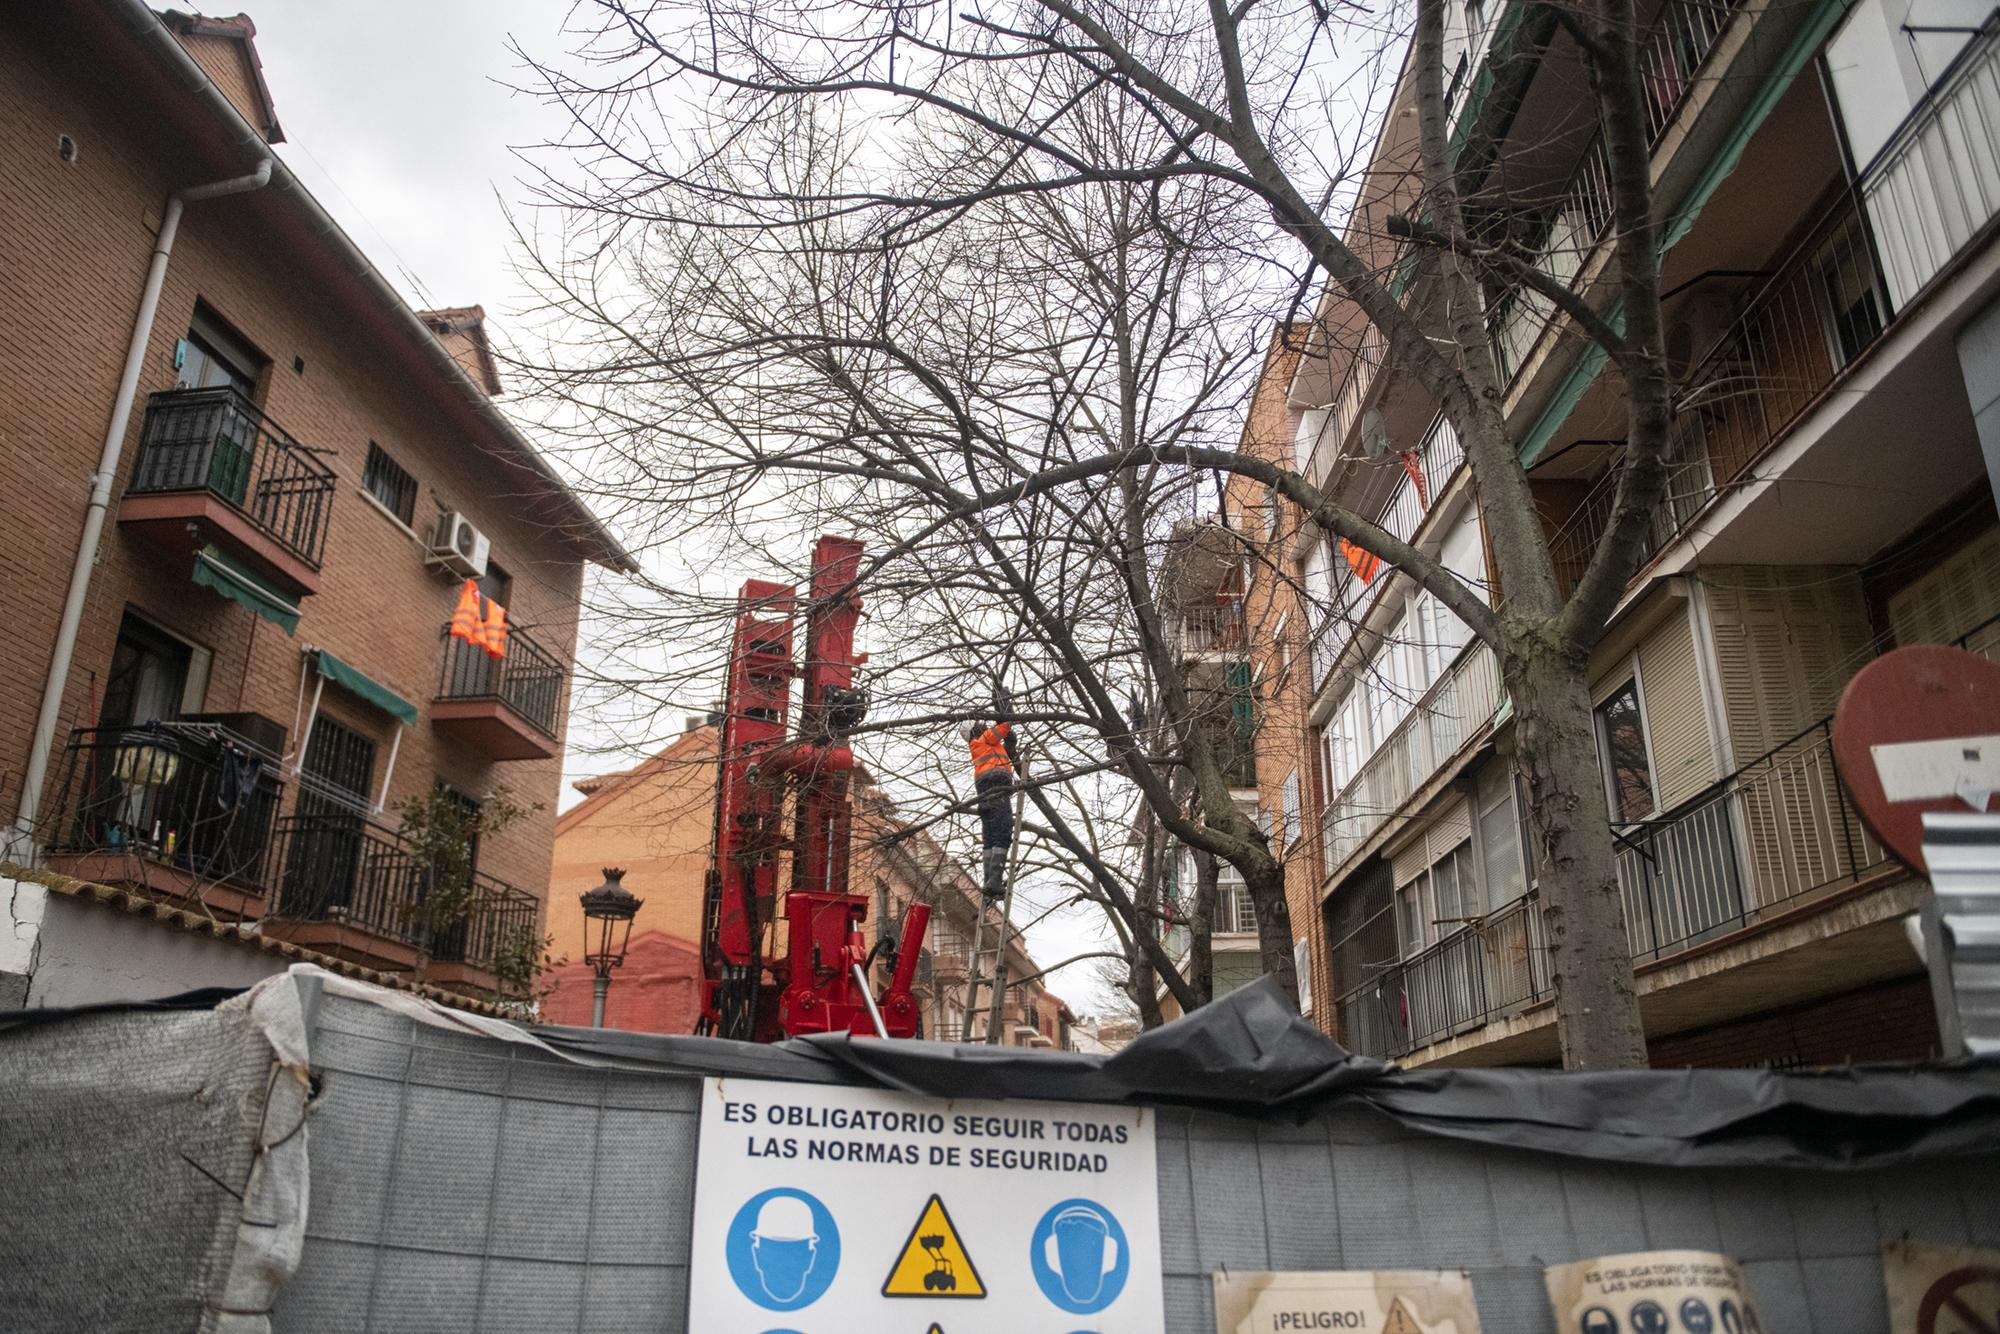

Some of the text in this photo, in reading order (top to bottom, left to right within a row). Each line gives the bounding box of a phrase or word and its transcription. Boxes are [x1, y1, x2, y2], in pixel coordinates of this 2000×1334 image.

[724, 1102, 1129, 1144] ES OBLIGATORIO SEGUIR TODAS
[747, 1136, 1108, 1173] LAS NORMAS DE SEGURIDAD
[1605, 1263, 1687, 1280] OBLIGATORIO
[1601, 1280, 1626, 1294] LAS
[1629, 1276, 1682, 1290] NORMAS
[1273, 1311, 1365, 1331] ¡PELIGRO!
